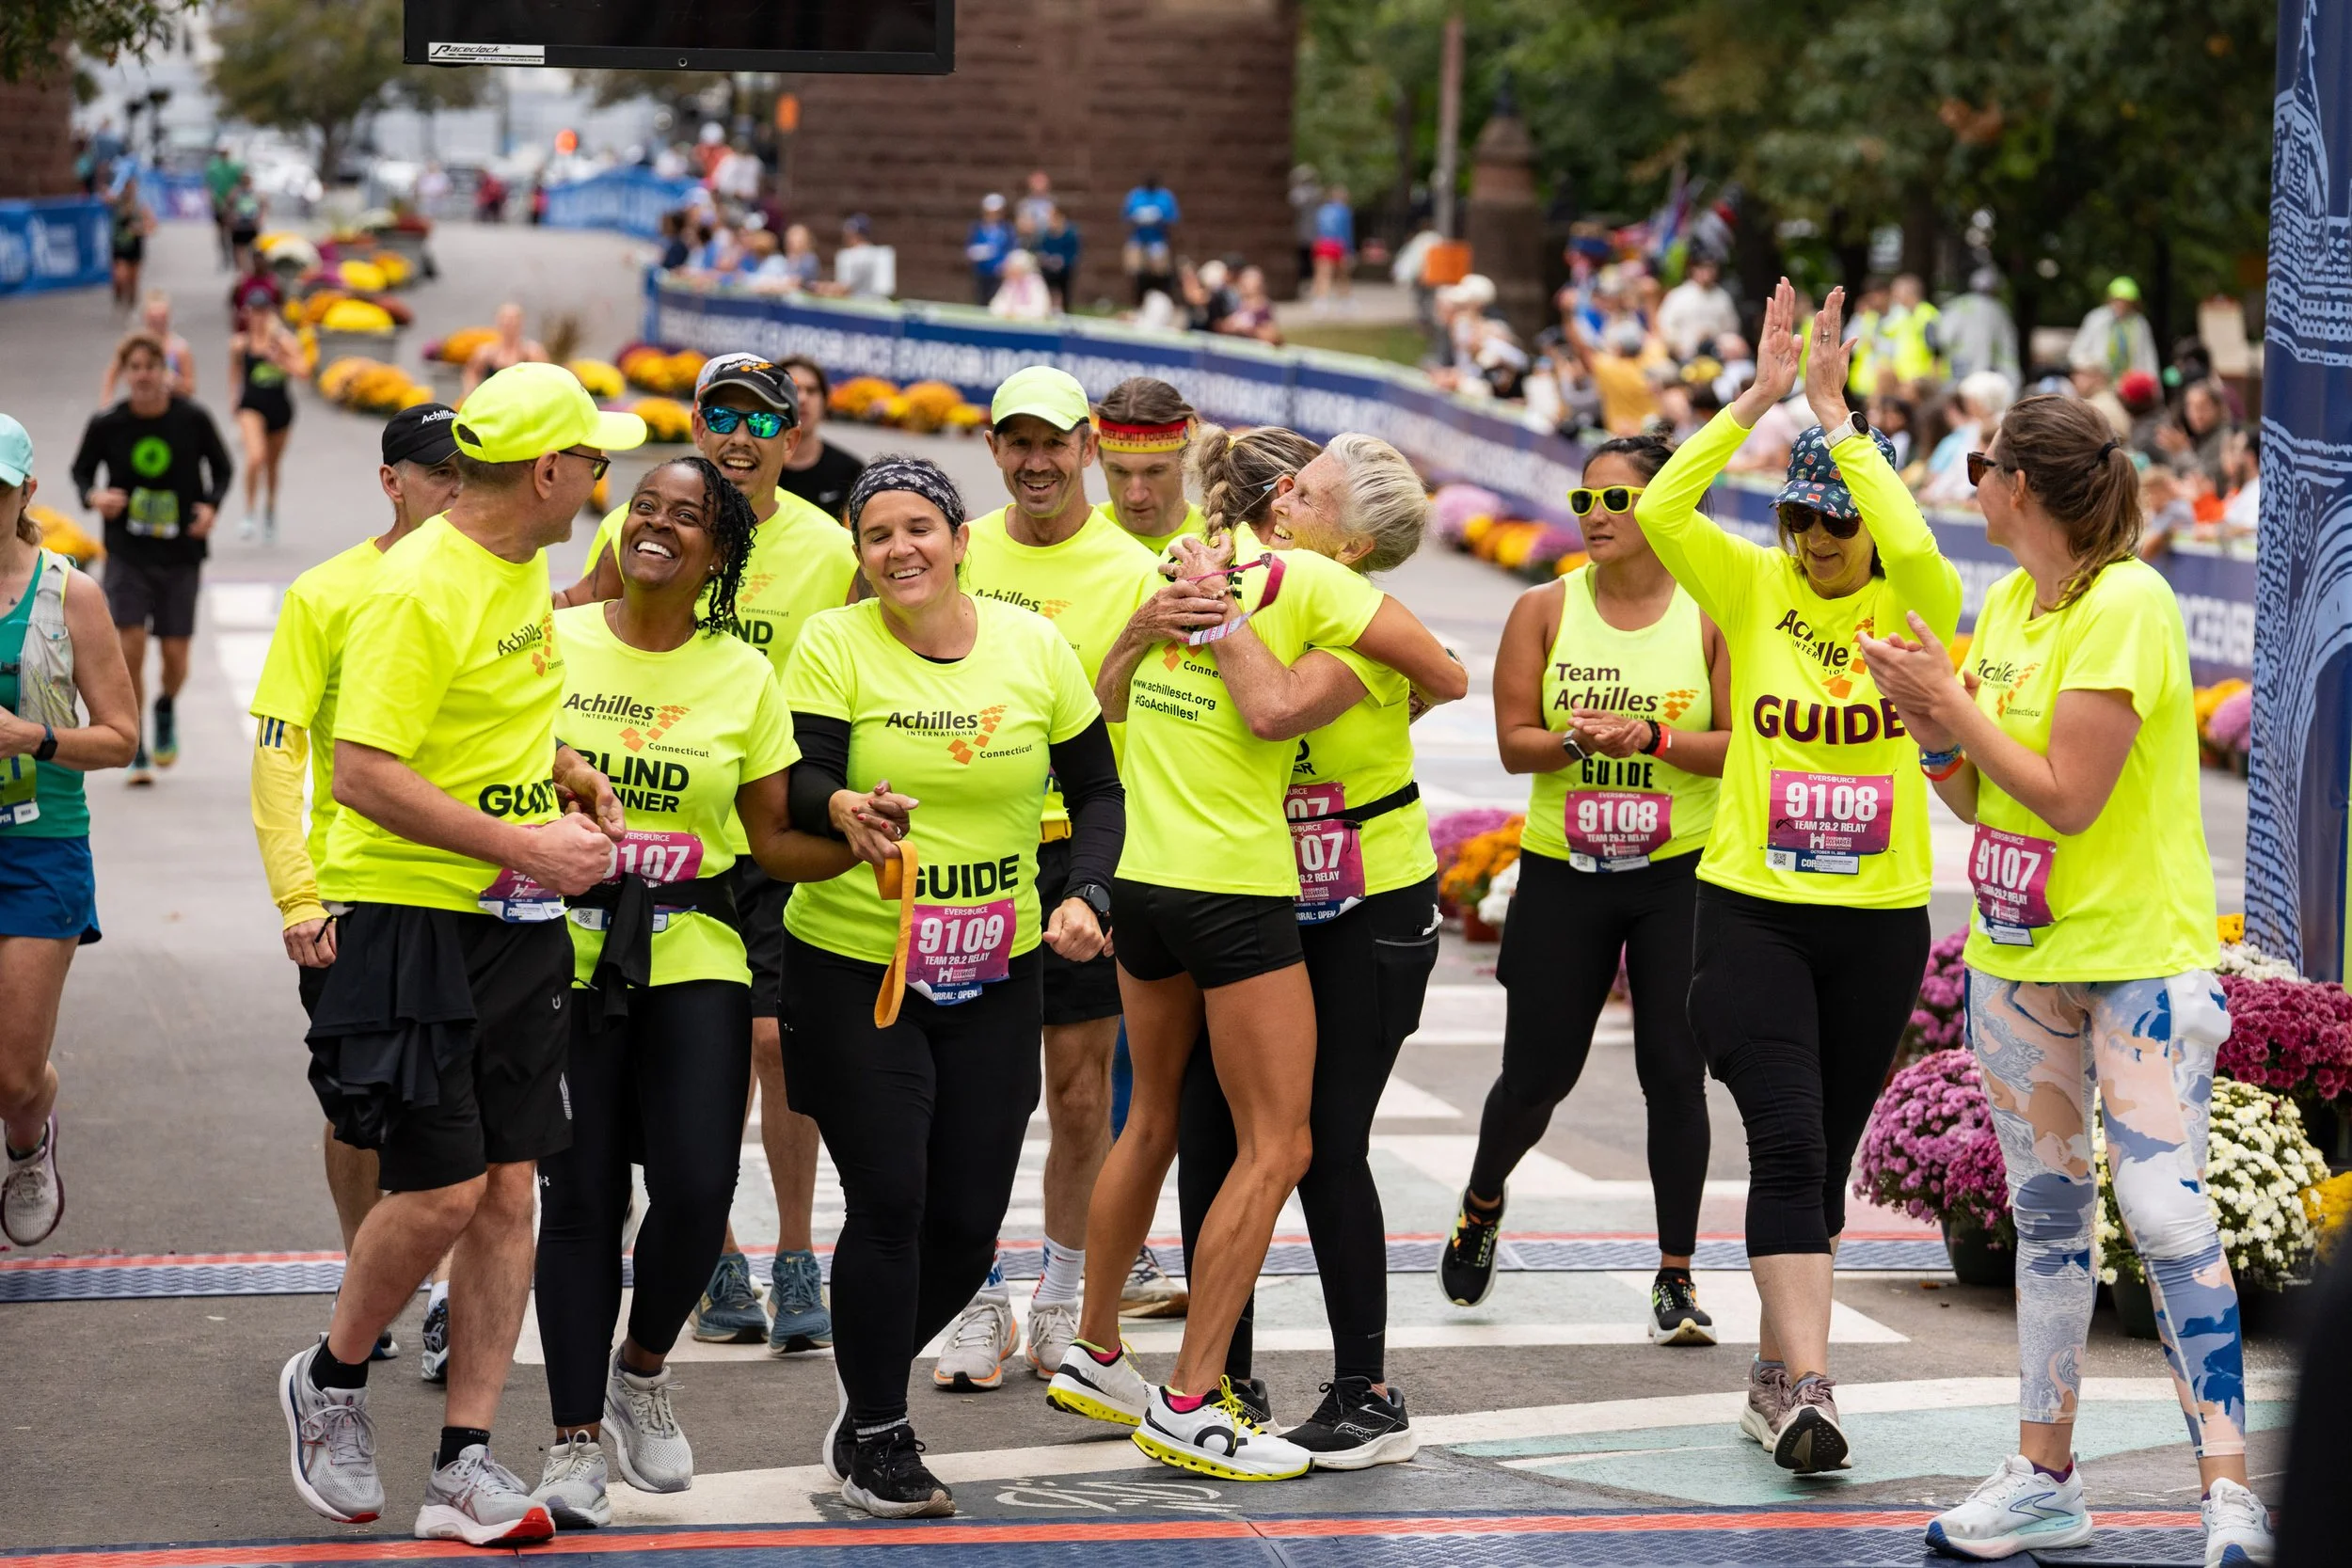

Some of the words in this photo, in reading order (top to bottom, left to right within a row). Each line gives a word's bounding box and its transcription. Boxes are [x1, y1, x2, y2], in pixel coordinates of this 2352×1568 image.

[430, 44, 501, 55] Raceclock
[740, 606, 789, 618] Connecticut
[1555, 662, 1620, 682] Team
[1133, 678, 1216, 710] www.achillesct.org
[1553, 686, 1659, 712] Achilles
[563, 692, 656, 721] Achilles
[1135, 693, 1199, 721] #GoAchilles!
[581, 713, 651, 728] INTERNATIONAL
[885, 710, 977, 730] Achilles
[1754, 694, 1907, 745] GUIDE
[648, 742, 710, 758] Connecticut
[979, 744, 1033, 759] Connecticut
[1581, 758, 1653, 788] GUIDE
[1808, 774, 1857, 784] EVERSOURCE
[1786, 782, 1879, 822] 9108
[1578, 800, 1659, 833] 9108
[1794, 820, 1818, 831] TEAM
[1820, 821, 1839, 832] 26.2
[1841, 823, 1867, 833] RELAY
[625, 832, 671, 842] VERSOURCE
[1587, 833, 1608, 843] TEAM
[1609, 833, 1626, 843] 26.2
[1628, 833, 1650, 843] RELAY
[1976, 838, 2042, 892] 9107
[1314, 871, 1340, 882] RELAY
[945, 906, 989, 916] EVERSOURCE
[1317, 910, 1336, 920] OPEN
[918, 914, 1005, 954] 9109
[925, 955, 947, 965] TEAM
[948, 955, 966, 965] 26.2
[968, 951, 991, 963] RELAY
[932, 991, 957, 1001] ORRAL:
[958, 990, 977, 999] OPEN
